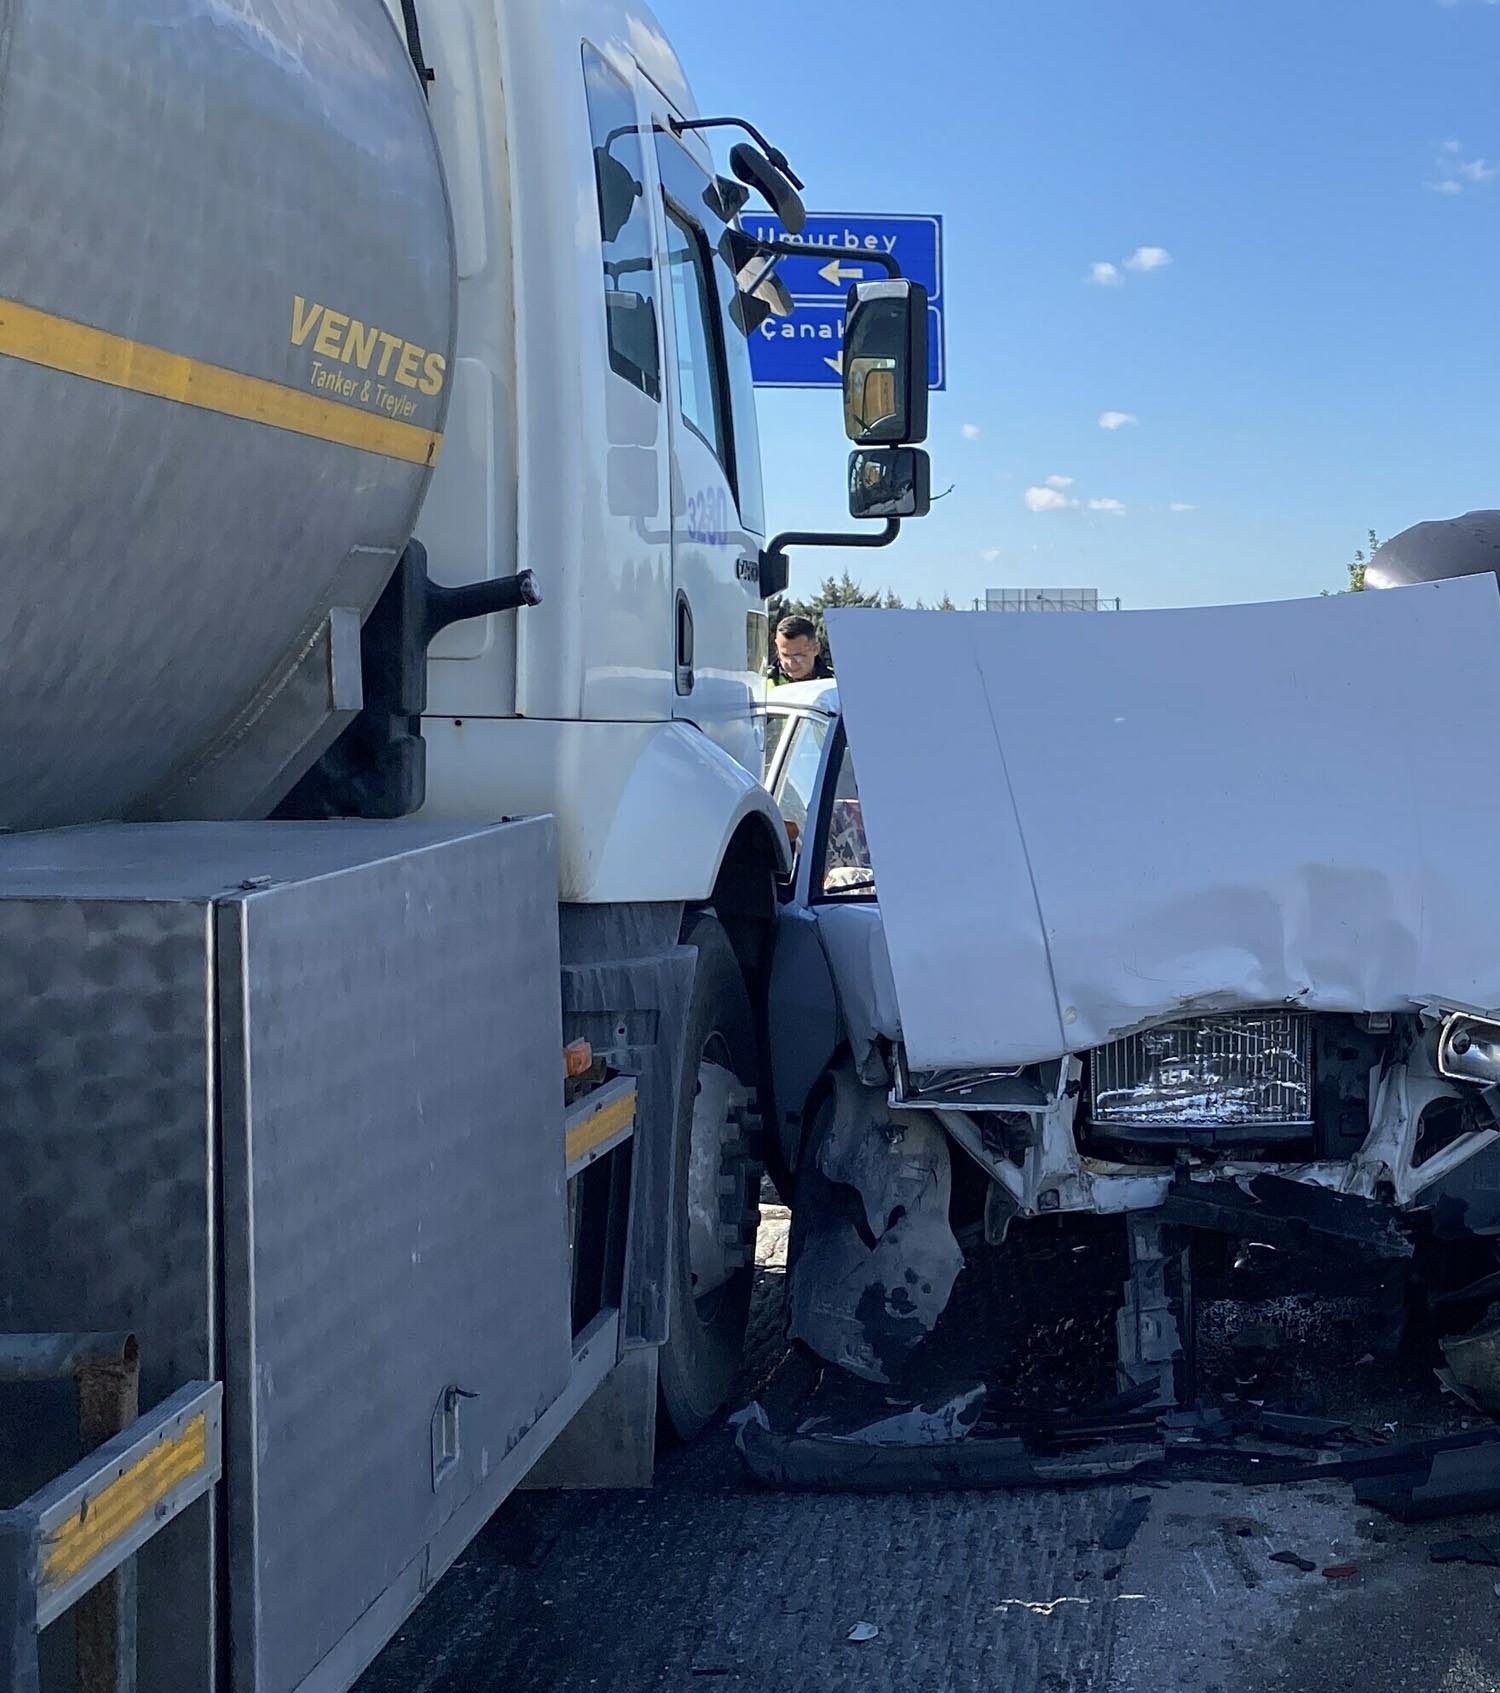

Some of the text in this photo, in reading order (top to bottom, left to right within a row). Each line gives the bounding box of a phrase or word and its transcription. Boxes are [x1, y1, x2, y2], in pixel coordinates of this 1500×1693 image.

[757, 227, 897, 253] Umurbey
[291, 296, 446, 396] VENTES
[311, 361, 417, 418] Tanker & Treyler
